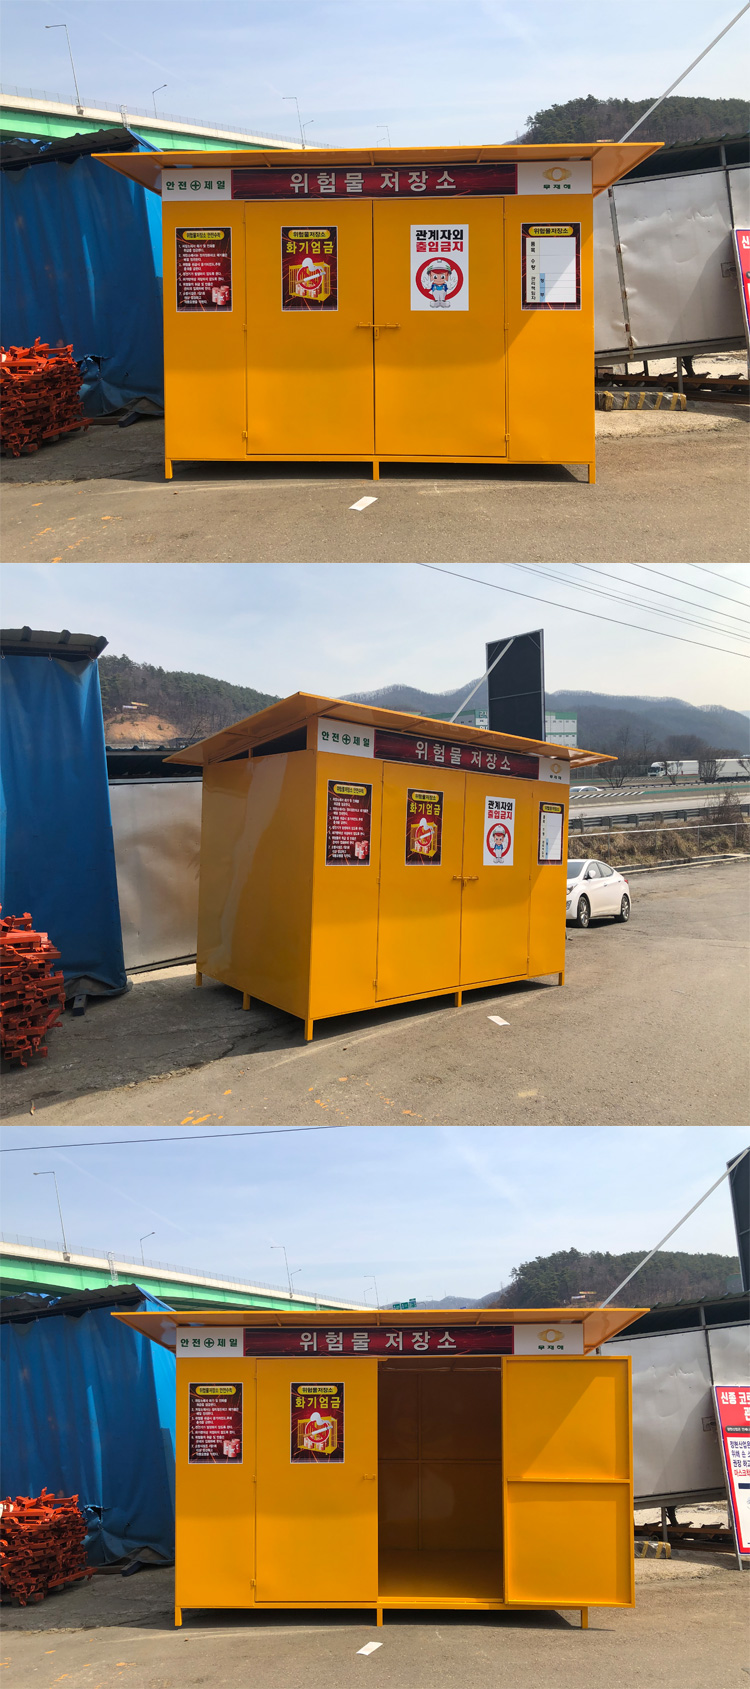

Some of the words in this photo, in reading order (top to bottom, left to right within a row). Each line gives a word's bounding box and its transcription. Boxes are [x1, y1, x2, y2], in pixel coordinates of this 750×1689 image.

[166, 180, 187, 190] 안전
[204, 180, 225, 190] 제일
[290, 172, 365, 194] 위험물
[380, 170, 457, 192] 저장소
[416, 230, 463, 240] 관계자외
[286, 241, 334, 254] 화기엄금
[416, 241, 463, 252] 출입금지
[322, 731, 339, 742] 안전
[353, 736, 370, 747] 제일
[416, 741, 461, 765] 위험물
[471, 751, 511, 770] 저장소
[410, 802, 440, 816] 화기엄금
[488, 800, 513, 811] 관계자외
[488, 810, 512, 820] 출입금지
[181, 1338, 200, 1348] 안전
[217, 1338, 238, 1348] 제일
[300, 1332, 371, 1351] 위험물
[385, 1331, 457, 1350] 저장소
[295, 1396, 340, 1409] 화기엄금
[721, 1392, 737, 1404] 신종
